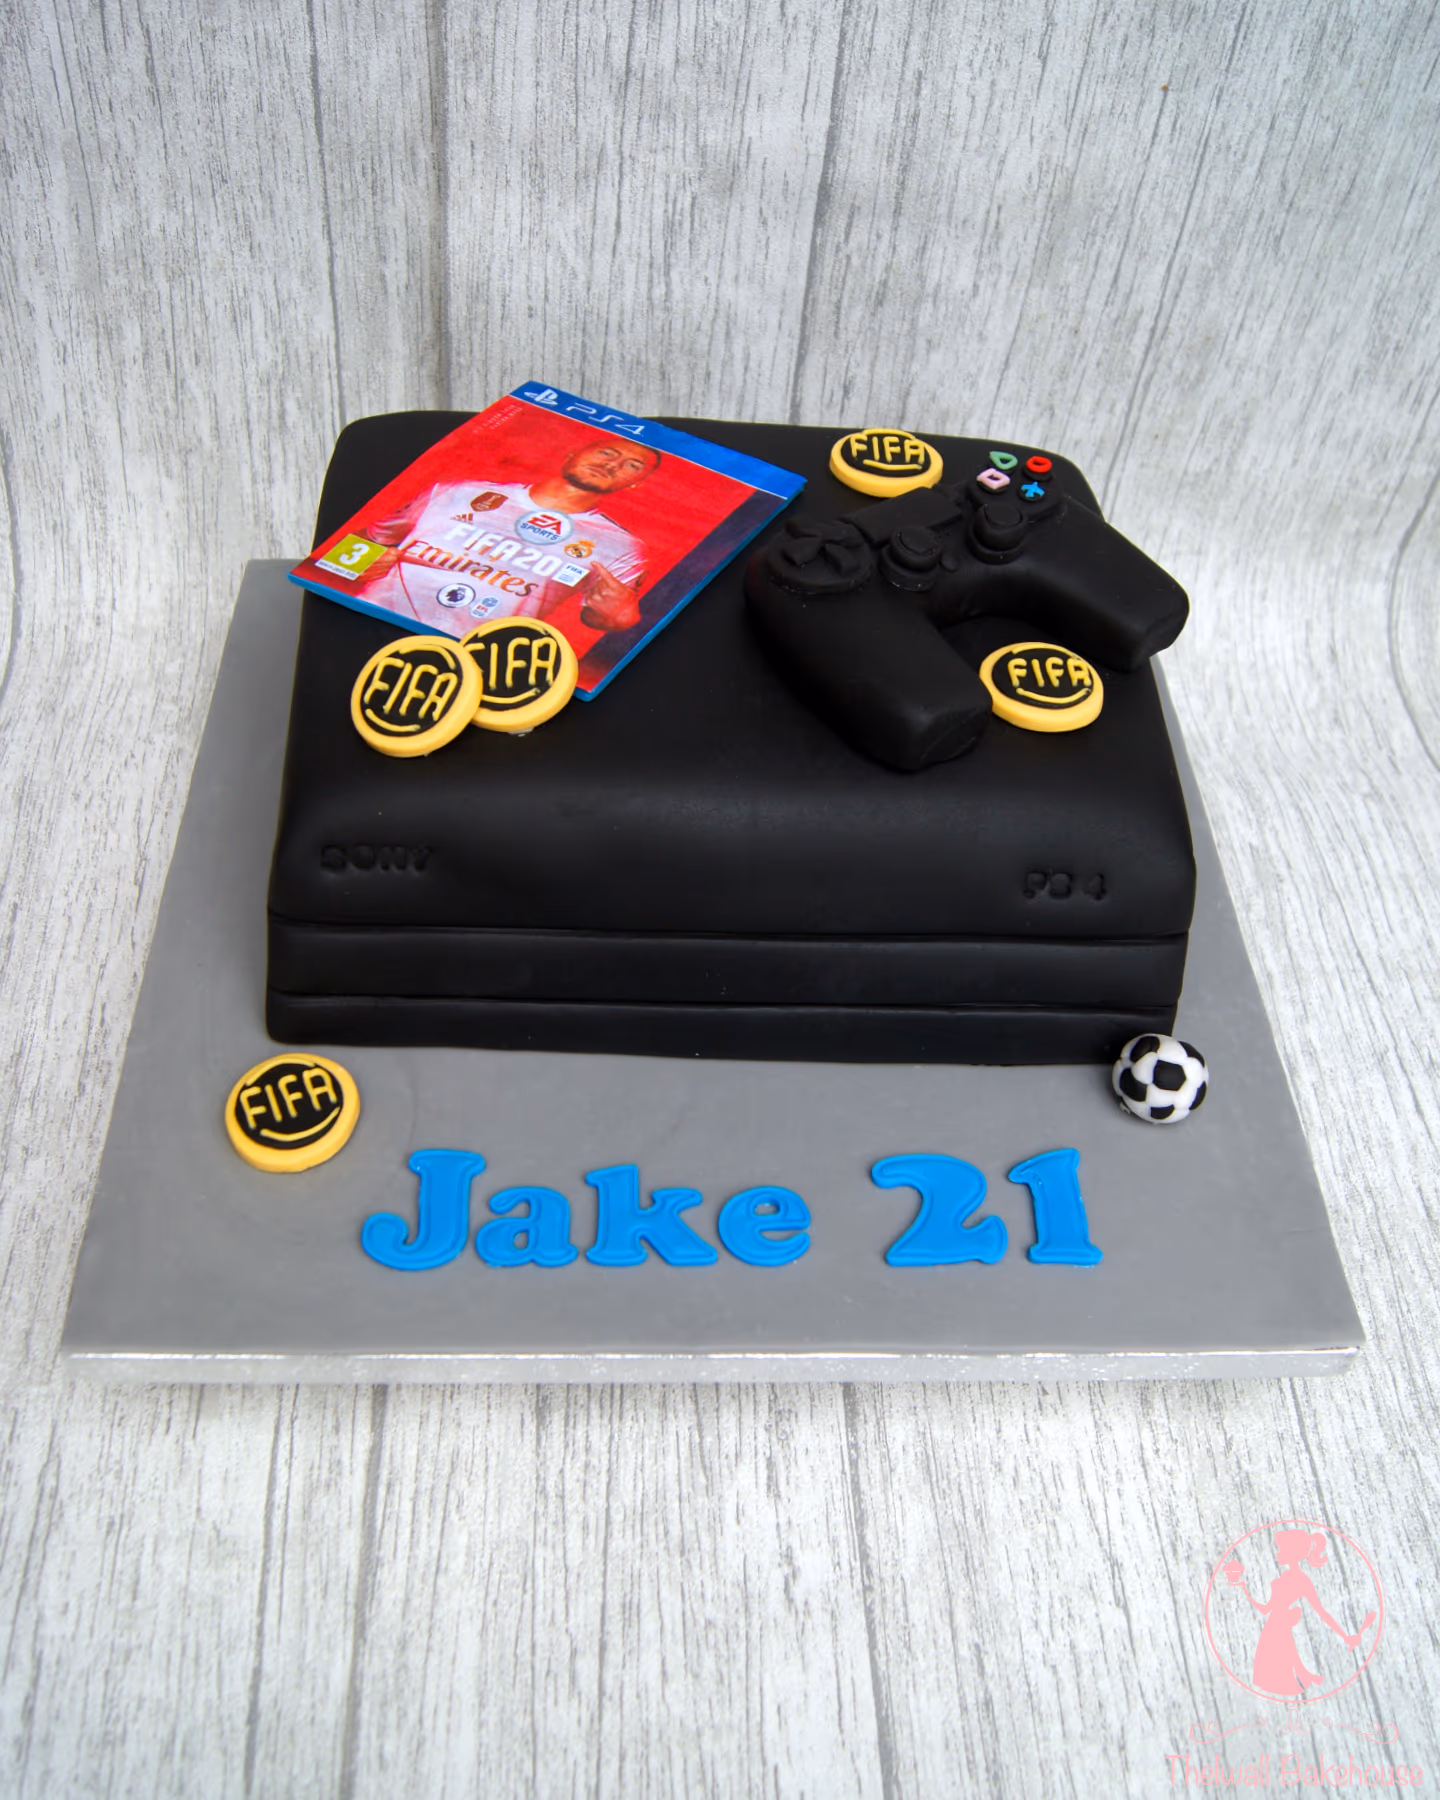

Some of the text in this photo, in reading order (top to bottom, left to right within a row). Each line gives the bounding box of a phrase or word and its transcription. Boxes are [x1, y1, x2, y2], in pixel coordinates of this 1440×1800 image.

[566, 402, 645, 436] PS4
[850, 434, 925, 464] FIFA
[520, 522, 560, 541] SPORTS
[527, 514, 562, 535] EA
[338, 542, 370, 566] 3
[400, 539, 539, 597] Emirates
[565, 564, 583, 576] FIFA
[1007, 656, 1092, 687] FIFA
[364, 656, 458, 721] FIFA
[239, 1068, 337, 1129] FIFA
[362, 1148, 1103, 1271] Jake 21
